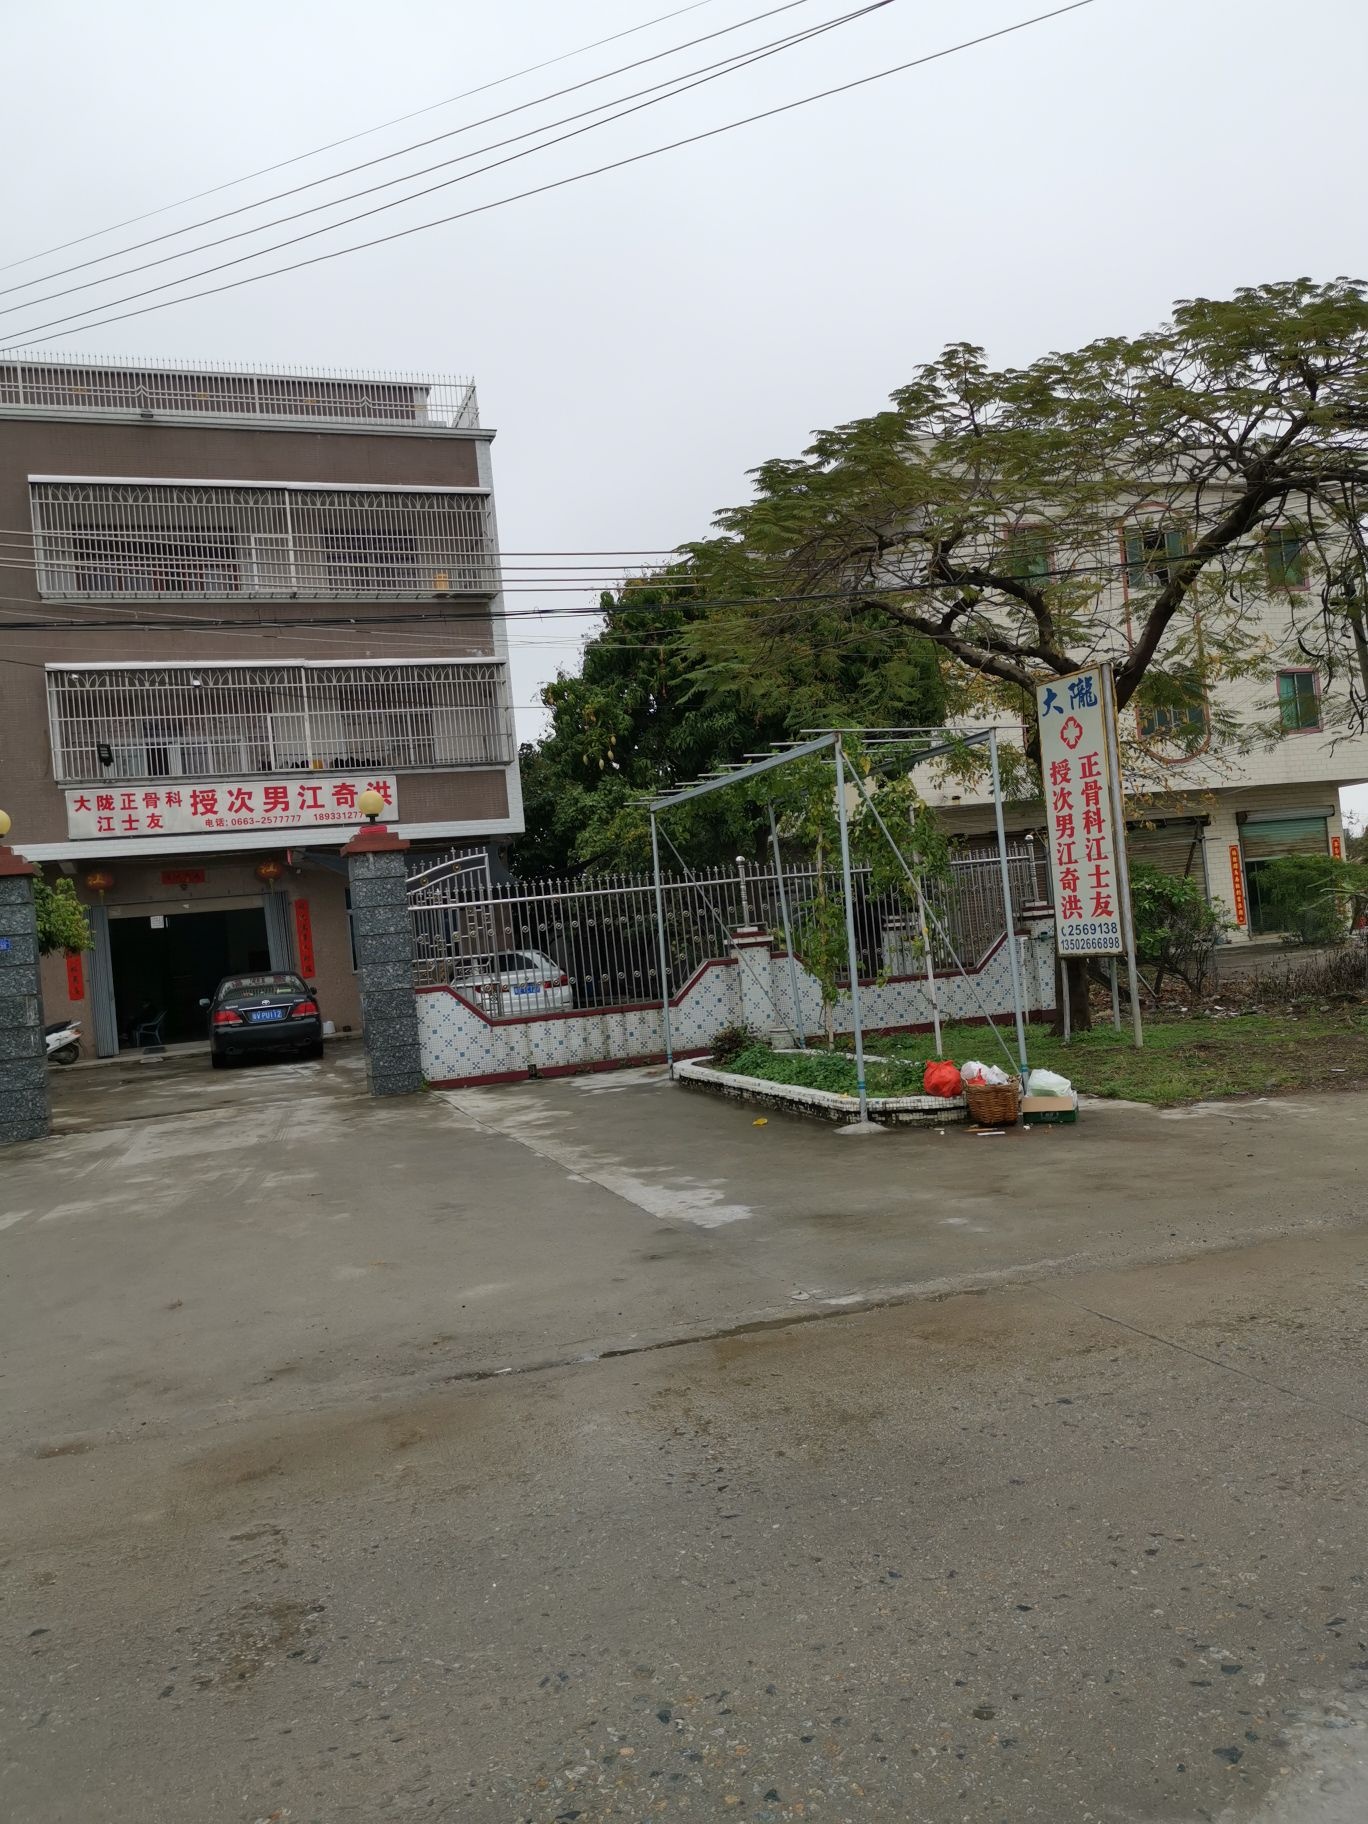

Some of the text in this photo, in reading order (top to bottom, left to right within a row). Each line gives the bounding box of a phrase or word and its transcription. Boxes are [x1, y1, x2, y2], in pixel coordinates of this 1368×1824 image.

[73, 791, 183, 813] 大陇正骨科
[97, 813, 164, 832] 江士友
[1049, 759, 1083, 921] 授次男江奇洪
[1078, 751, 1114, 919] 正骨科江士友
[1067, 922, 1118, 938] 2569138
[1061, 936, 1120, 951] 13502666898
